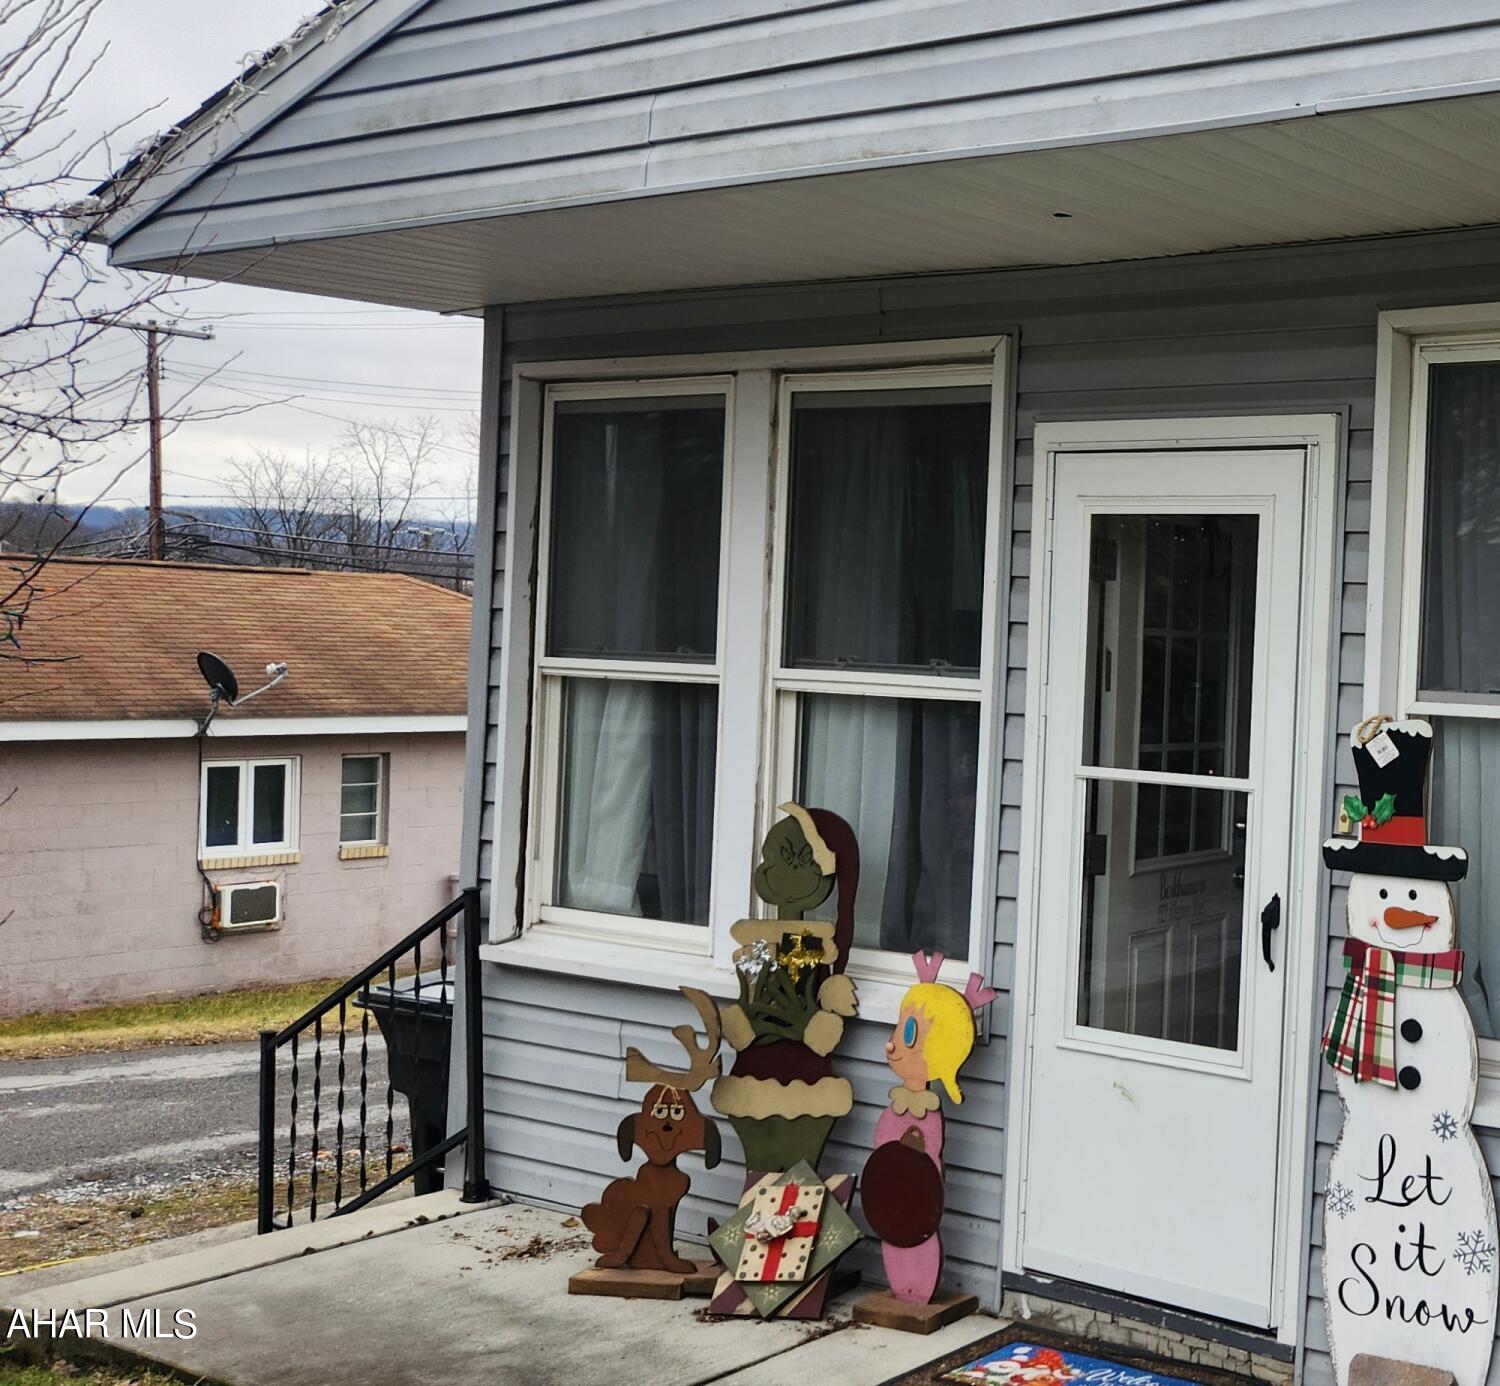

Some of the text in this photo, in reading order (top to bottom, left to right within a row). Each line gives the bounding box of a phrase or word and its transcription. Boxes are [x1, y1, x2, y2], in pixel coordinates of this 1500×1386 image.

[1358, 1133, 1452, 1207] Let
[1394, 1222, 1446, 1277] it
[1338, 1242, 1489, 1333] Snow
